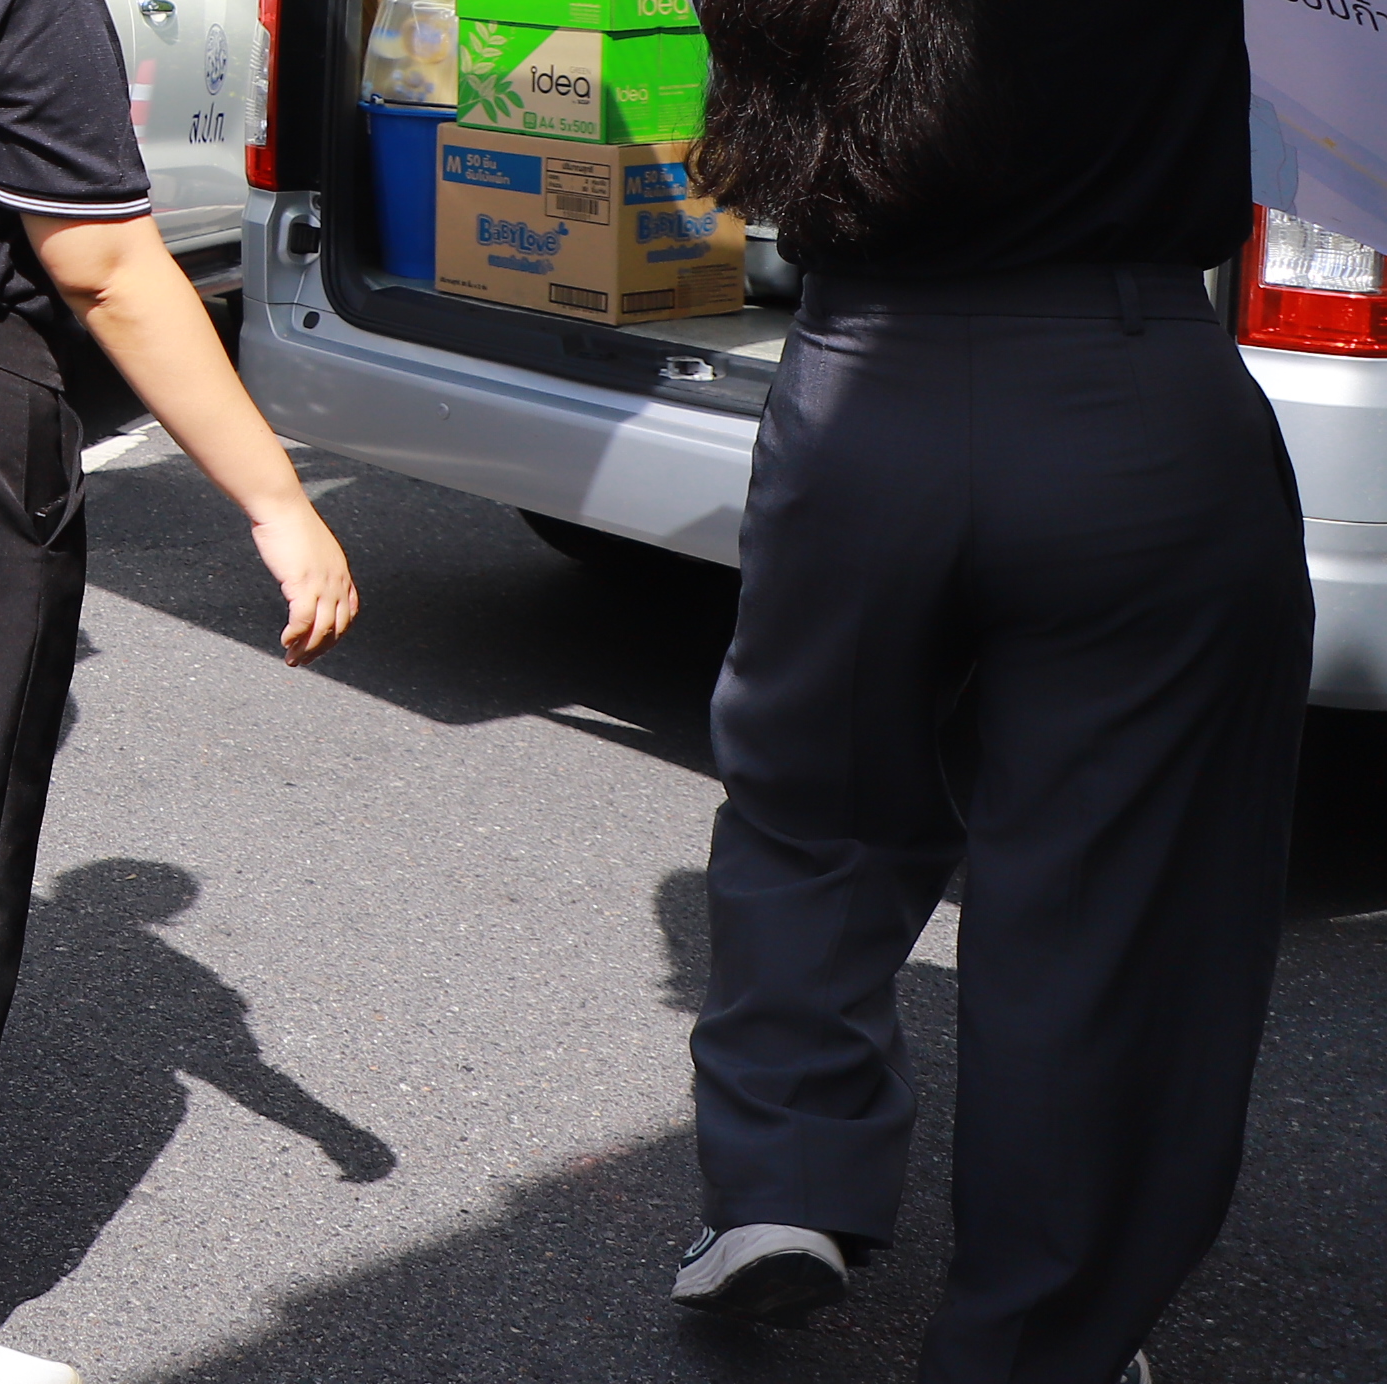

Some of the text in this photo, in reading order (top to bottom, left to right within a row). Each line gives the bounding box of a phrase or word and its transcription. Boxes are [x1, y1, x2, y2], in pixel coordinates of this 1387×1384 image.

[530, 64, 591, 99] idea
[616, 85, 649, 103] idea
[538, 115, 555, 129] A4
[446, 155, 461, 174] M
[466, 153, 481, 167] 50
[627, 177, 642, 195] M
